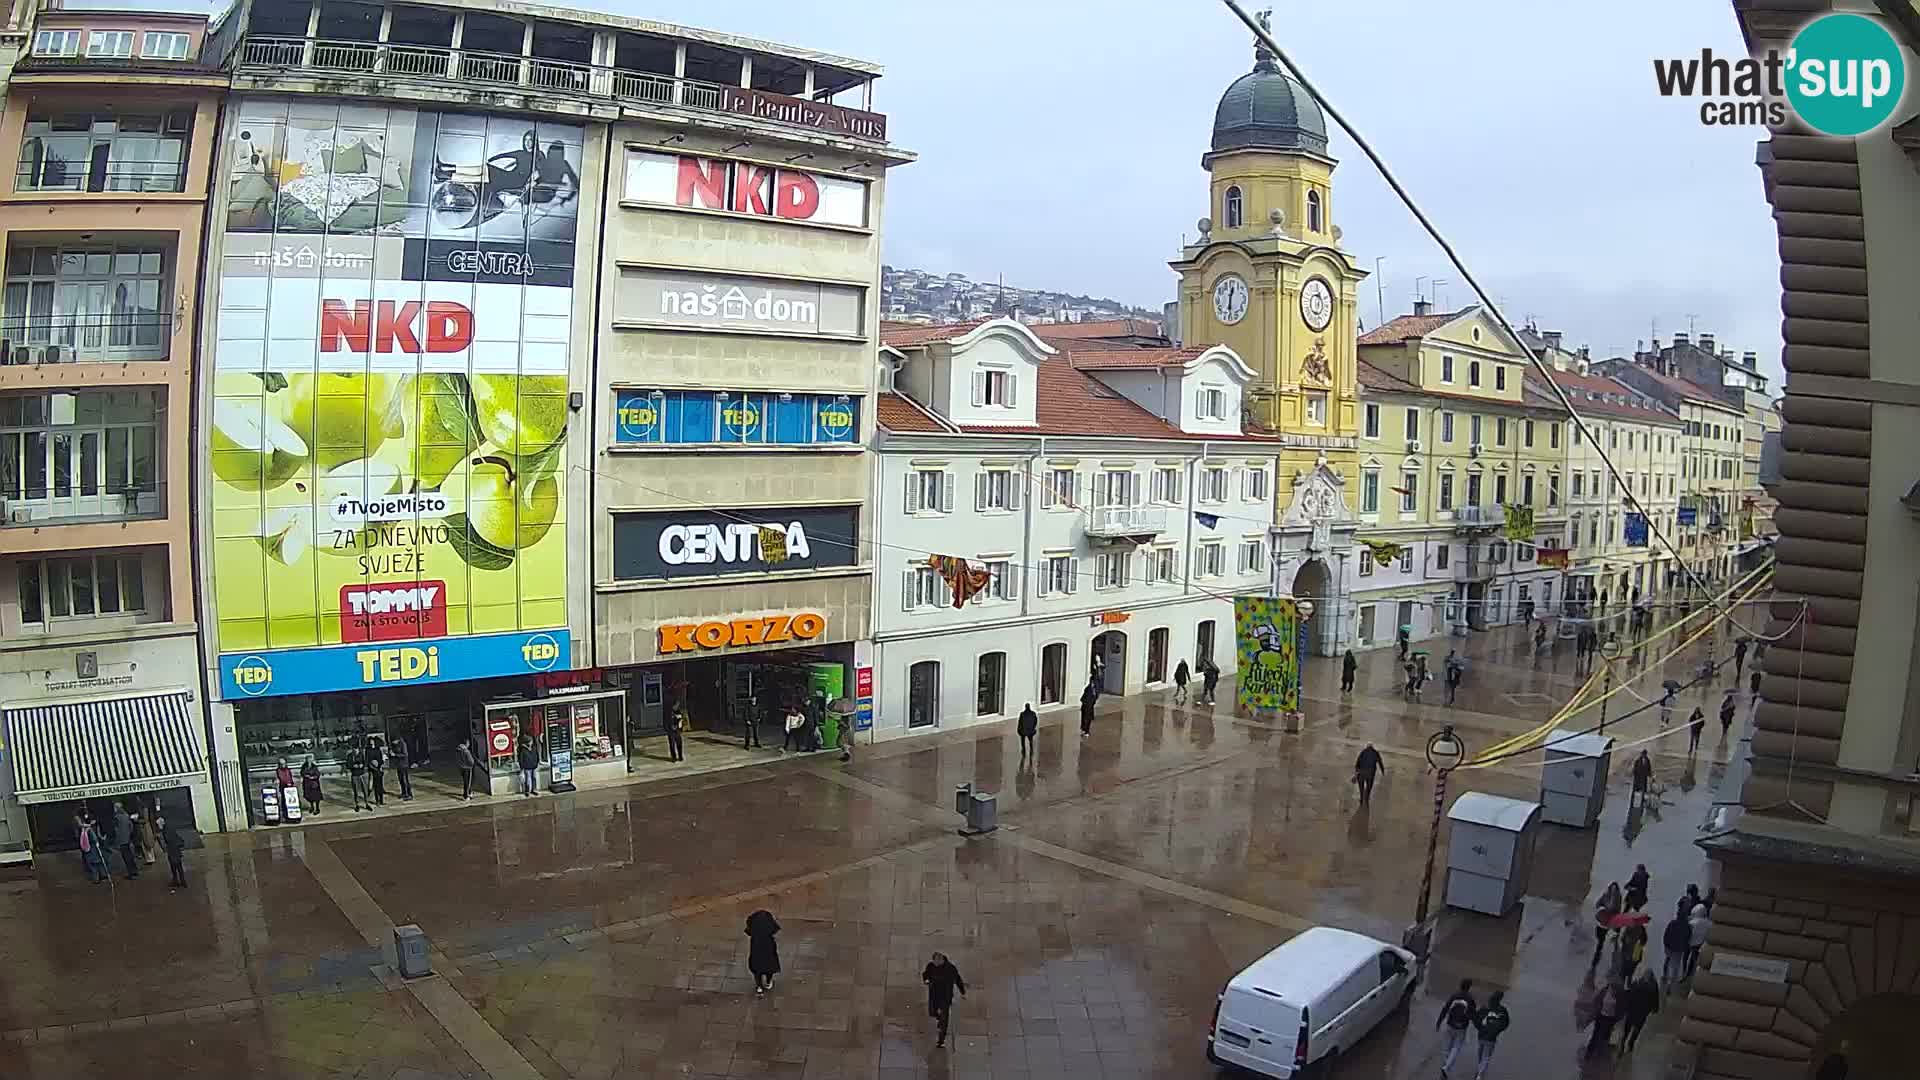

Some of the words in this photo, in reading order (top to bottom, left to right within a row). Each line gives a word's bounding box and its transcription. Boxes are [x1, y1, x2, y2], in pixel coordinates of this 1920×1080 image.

[722, 89, 745, 113] Le
[675, 158, 820, 219] NKD
[447, 250, 534, 276] CENTRA
[660, 283, 718, 317] naš
[753, 290, 816, 324] dom
[320, 298, 476, 354] NKD
[618, 408, 658, 426] TEDi
[722, 408, 759, 426] TEDi
[819, 411, 853, 428] TEDi
[337, 497, 446, 517] #TvojeMisto
[333, 529, 357, 549] ZA
[365, 524, 450, 549] DNEVNO
[358, 548, 425, 575] SVJEŽE
[346, 586, 440, 616] TOMMY
[657, 613, 826, 655] KORZO
[356, 646, 441, 683] TEDi
[520, 642, 560, 662] TEDi
[232, 665, 273, 686] TEDi
